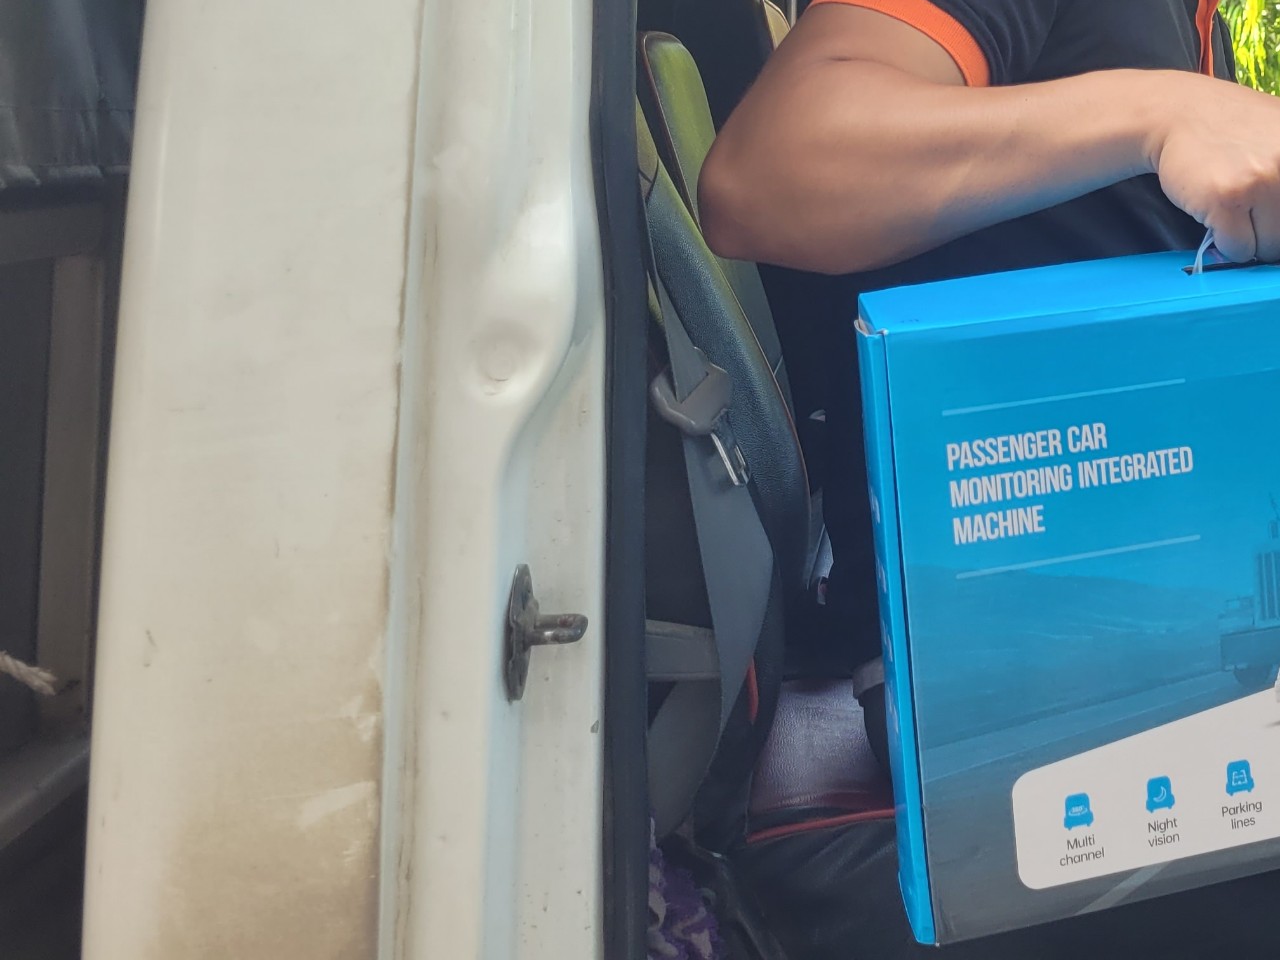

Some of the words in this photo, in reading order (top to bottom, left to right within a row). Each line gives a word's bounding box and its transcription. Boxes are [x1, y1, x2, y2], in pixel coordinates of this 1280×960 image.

[946, 428, 1063, 471] PASSENGER
[1067, 422, 1107, 454] CAR
[949, 464, 1073, 508] MONITORING
[1078, 446, 1194, 489] INTEGRATED
[952, 504, 1046, 545] MACHINE
[1221, 799, 1263, 818] Parking
[1147, 817, 1178, 836] Night
[1230, 815, 1256, 830] lines
[1066, 833, 1096, 851] Multi
[1148, 831, 1180, 848] vision
[1059, 847, 1105, 867] channel
